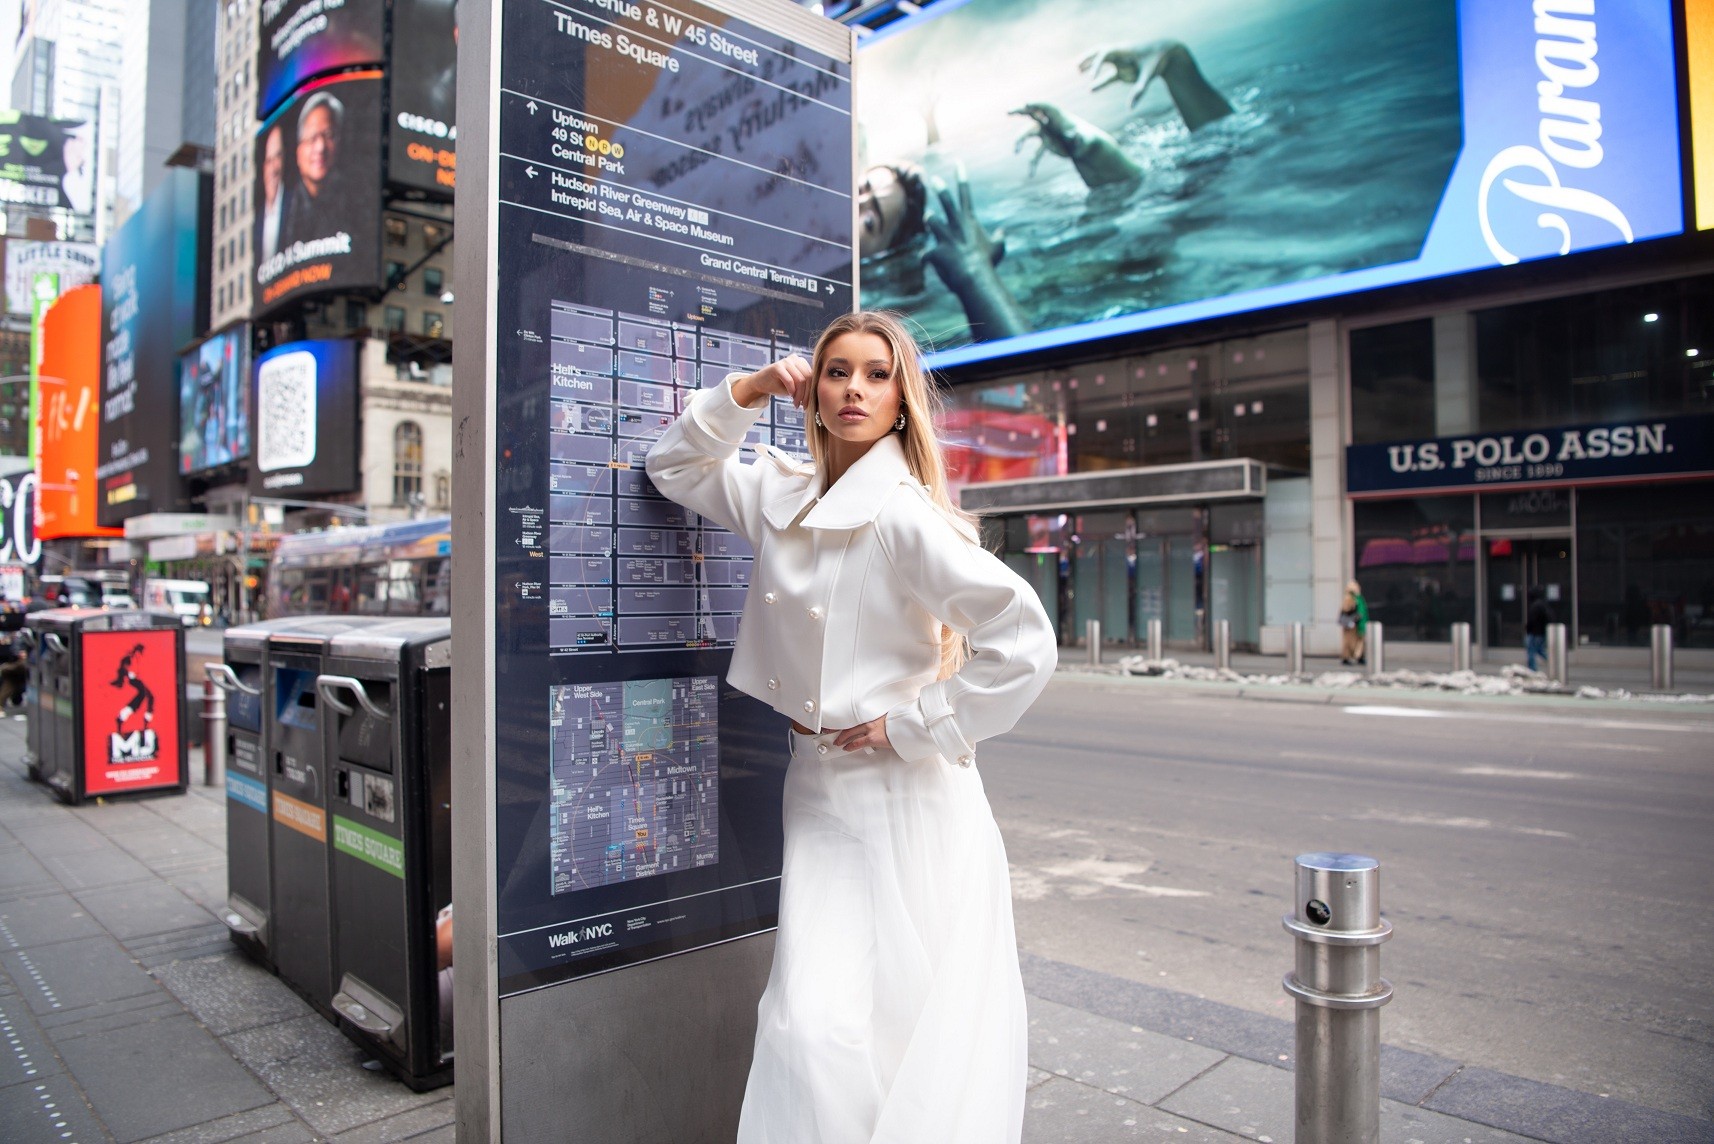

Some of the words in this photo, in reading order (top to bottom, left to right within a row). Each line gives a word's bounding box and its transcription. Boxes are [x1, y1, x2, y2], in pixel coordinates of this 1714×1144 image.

[553, 10, 613, 49] Times
[616, 34, 680, 73] Square
[645, 8, 660, 29] &
[663, 13, 682, 37] W
[684, 24, 707, 46] 45
[709, 32, 758, 67] Street
[397, 112, 448, 138] CISCO
[552, 109, 599, 134] Uptown
[551, 127, 568, 141] 49
[569, 131, 584, 147] St
[551, 144, 595, 167] Central
[598, 156, 625, 175] Park
[551, 172, 598, 195] Hudson
[600, 184, 630, 203] River
[632, 194, 687, 220] Greenway
[551, 189, 597, 211] Intrepid
[599, 201, 624, 220] Sea,
[626, 208, 643, 222] Air
[644, 213, 653, 226] &
[654, 215, 689, 234] Space
[691, 224, 734, 246] Museum
[18, 245, 60, 264] LITTLE
[293, 231, 351, 263] Summit
[700, 253, 731, 271] Grand
[733, 261, 768, 280] Central
[769, 269, 807, 289] Terminal
[687, 313, 705, 322] Uptown
[553, 362, 582, 377] Hell's
[553, 375, 593, 390] Kitchen
[1389, 445, 1446, 472] U.S.
[1451, 433, 1550, 468] POLO
[1556, 423, 1674, 461] ASSN.
[1474, 464, 1522, 482] SINCE
[1527, 462, 1564, 479] 1890
[574, 685, 592, 693] Upper
[692, 678, 708, 686] Upper
[574, 691, 589, 699] West
[111, 729, 156, 758] MJ
[667, 765, 697, 775] Midtown
[587, 811, 610, 820] Kitchen
[627, 822, 648, 831] Square
[334, 823, 364, 852] TIMES
[363, 836, 403, 870] SQUARE
[635, 862, 659, 871] Garment
[635, 869, 656, 878] District
[549, 930, 579, 948] Walk
[585, 923, 613, 940] NYC
